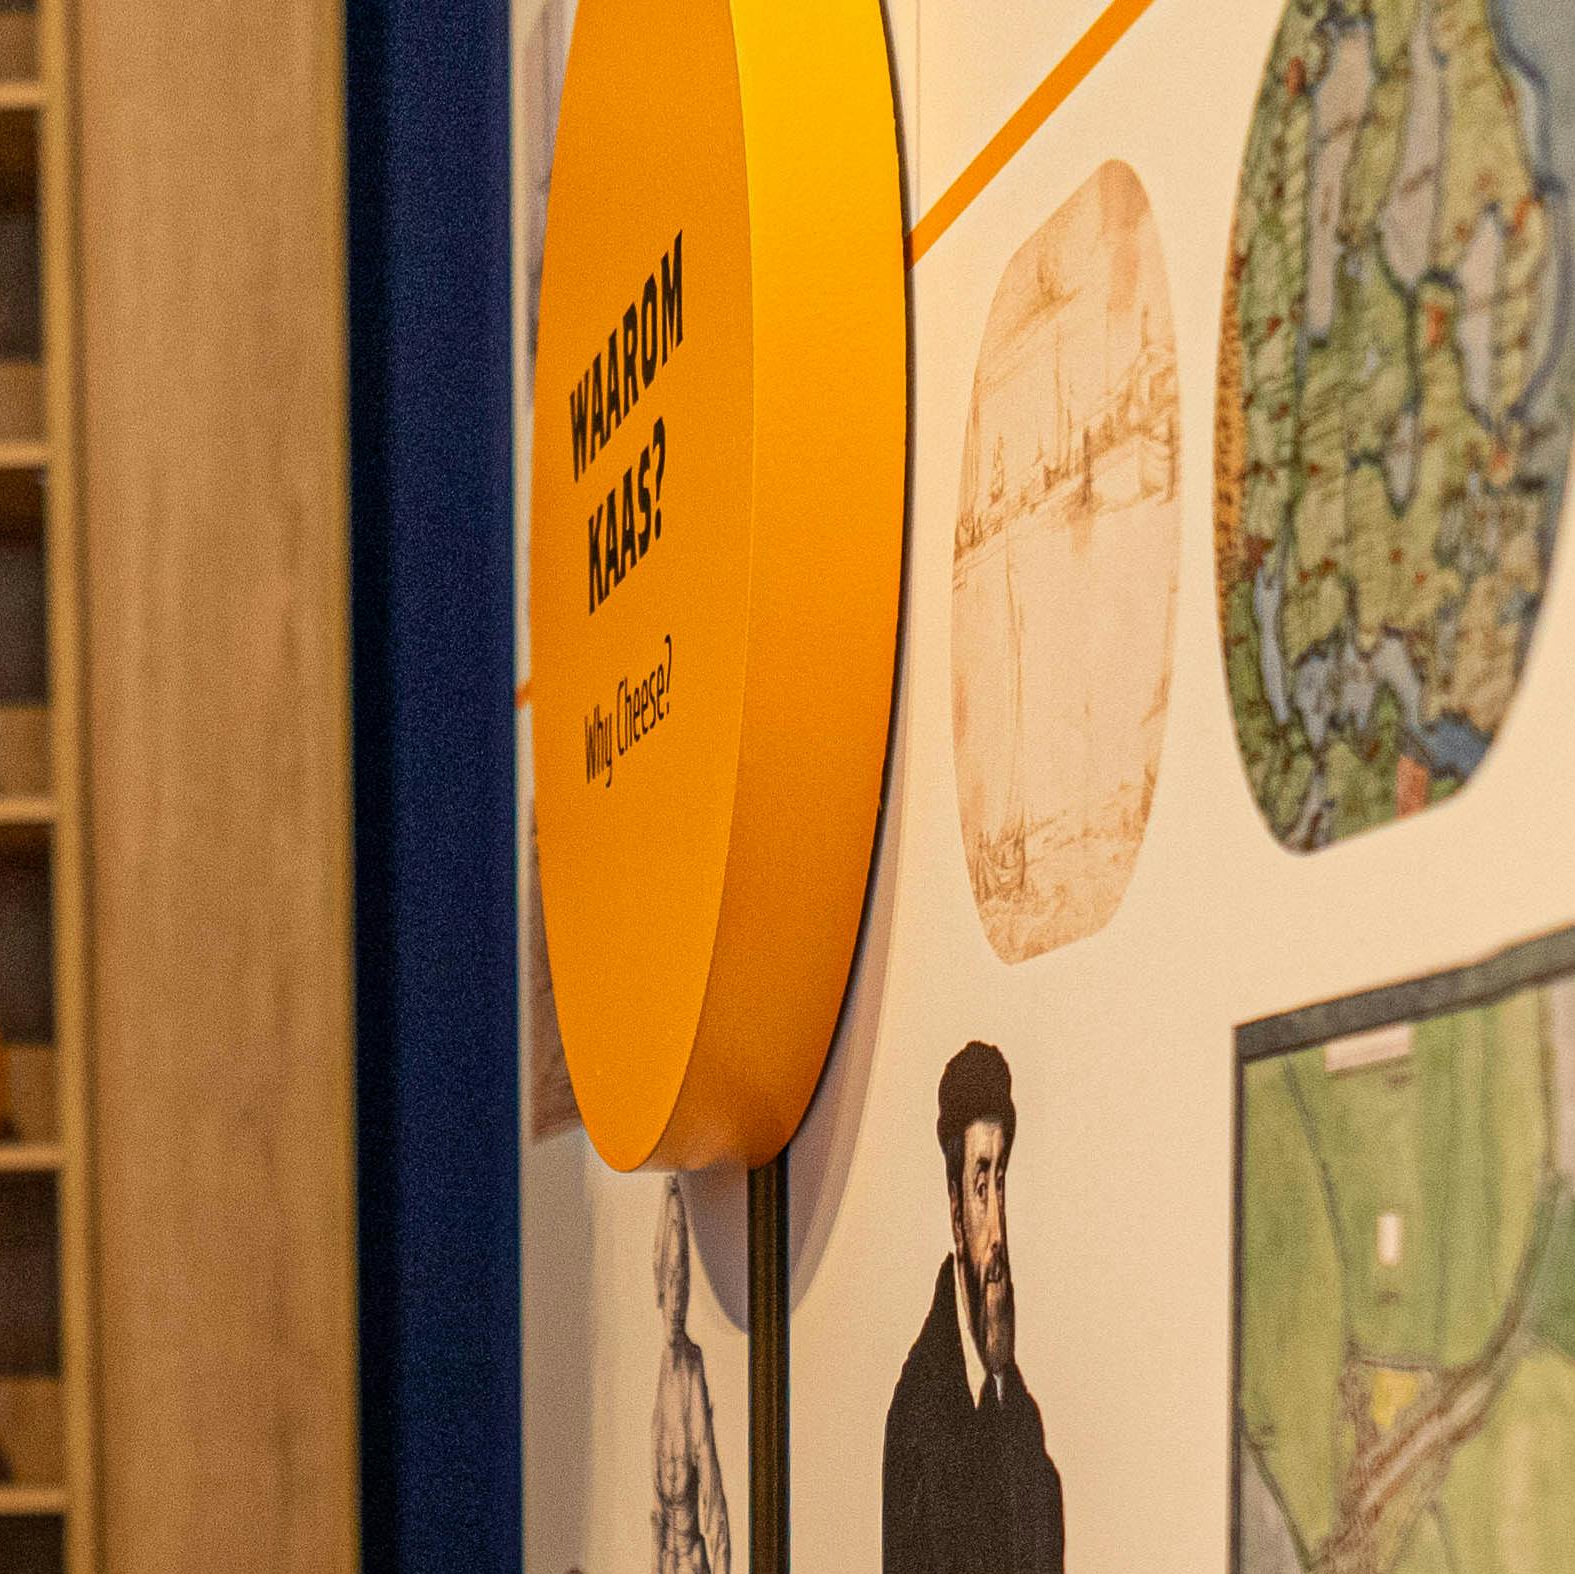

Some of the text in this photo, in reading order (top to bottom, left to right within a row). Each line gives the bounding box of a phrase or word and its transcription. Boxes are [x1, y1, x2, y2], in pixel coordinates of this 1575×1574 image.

[568, 229, 683, 482] WAAROM
[588, 416, 667, 616] KAAS?
[584, 634, 672, 788] Why Cheese?
